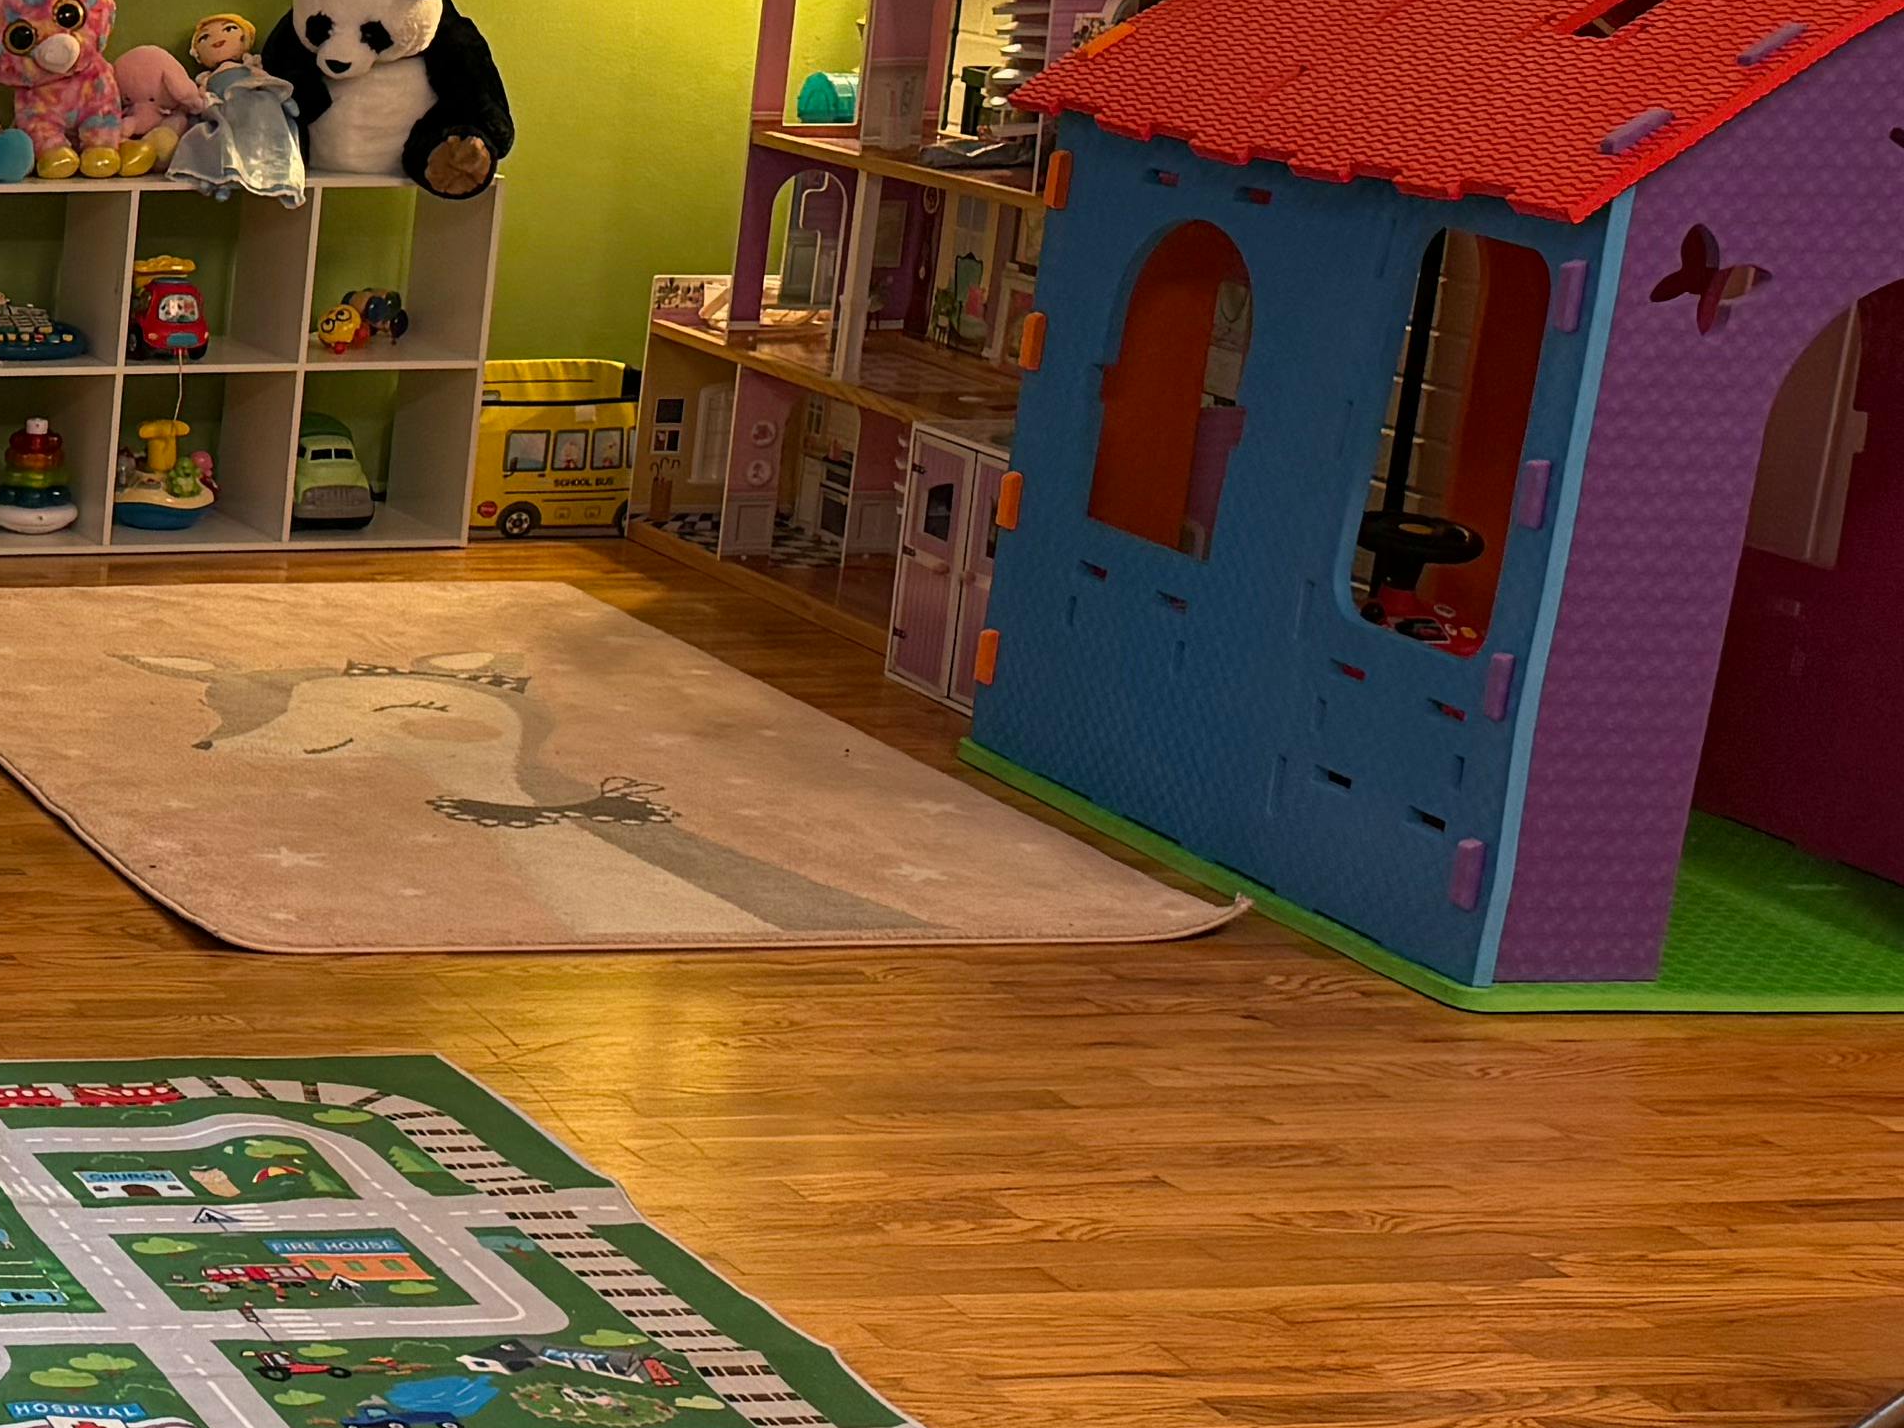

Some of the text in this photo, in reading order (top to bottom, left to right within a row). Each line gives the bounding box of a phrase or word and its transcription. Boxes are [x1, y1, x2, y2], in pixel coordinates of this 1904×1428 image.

[553, 476, 614, 488] SCHOOL BUS
[88, 1172, 174, 1182] CHURCH
[272, 1239, 399, 1253] FIRE HOUSE
[541, 1348, 610, 1364] FARM
[12, 1402, 142, 1417] HOSPITAL
